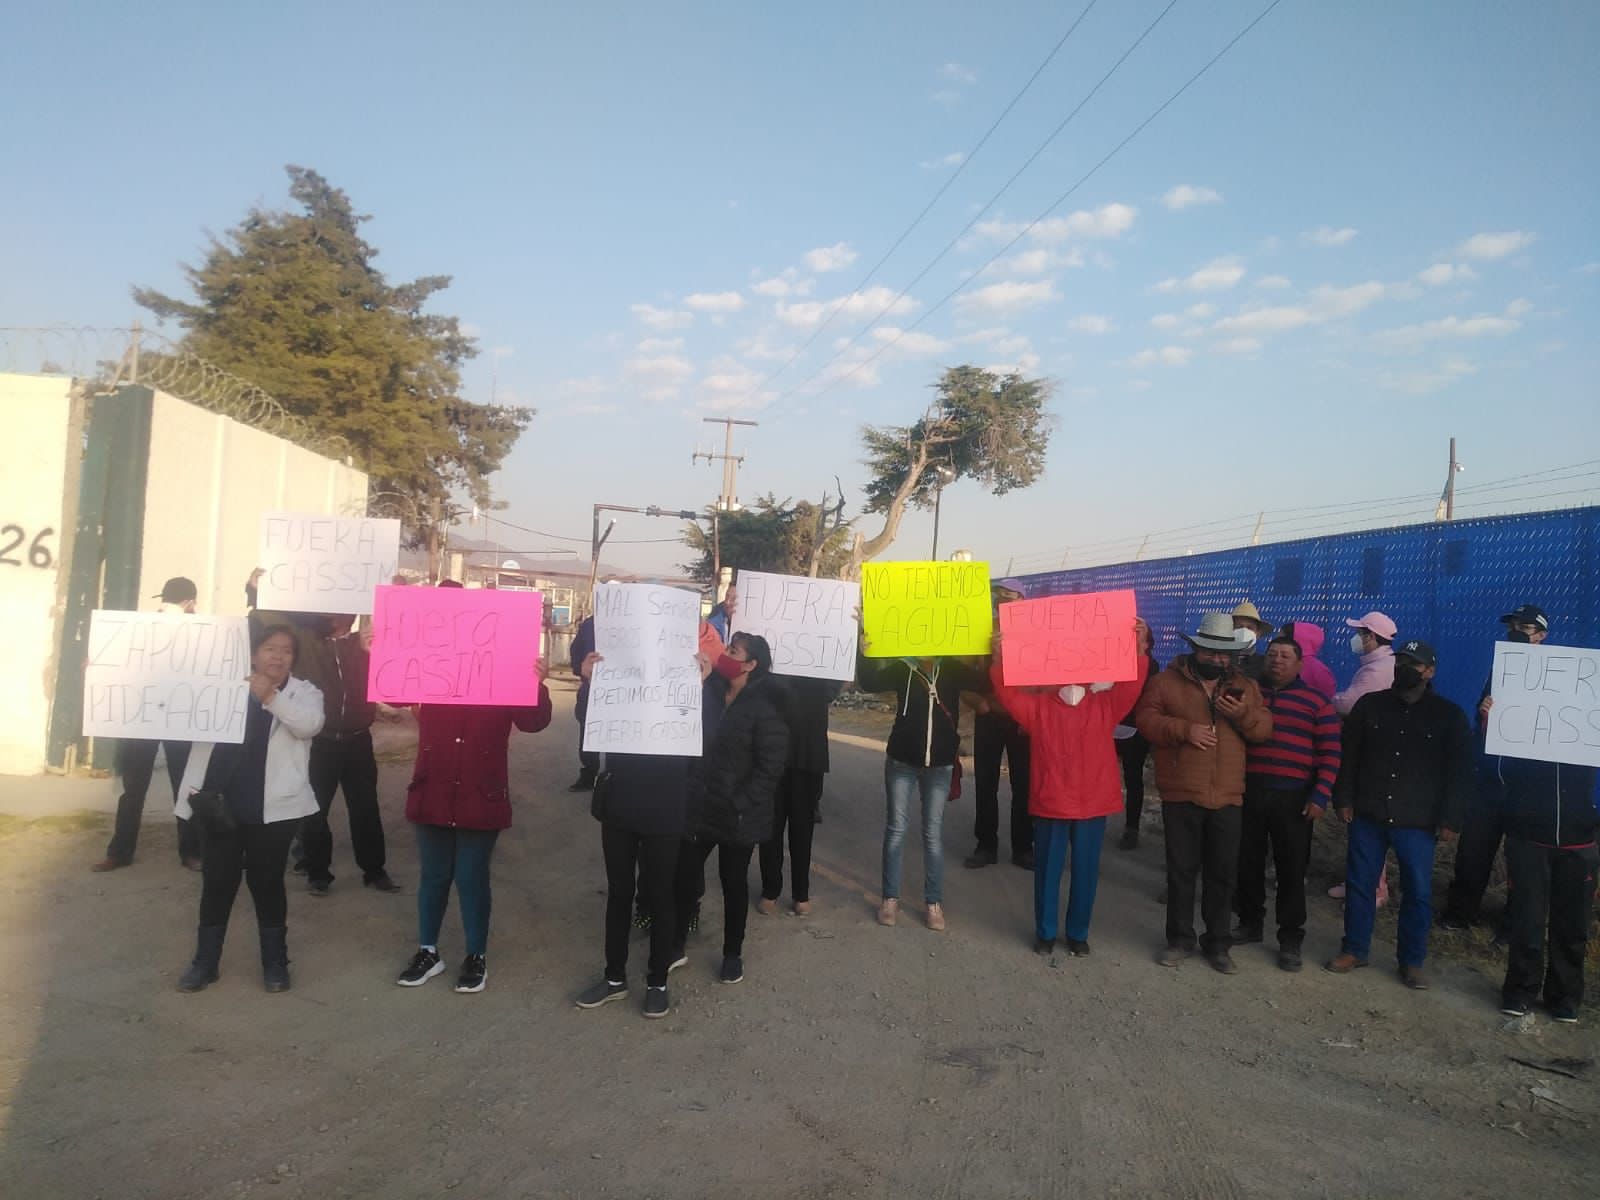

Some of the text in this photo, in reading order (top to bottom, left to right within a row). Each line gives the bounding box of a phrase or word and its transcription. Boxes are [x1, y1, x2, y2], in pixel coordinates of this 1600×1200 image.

[0, 524, 54, 569] 26
[270, 562, 397, 593] CASSIM
[864, 565, 985, 600] NO TENEMOS
[595, 589, 633, 617] MAL
[743, 577, 846, 625] FUERA
[881, 604, 970, 647] AGUA
[88, 619, 249, 681] ZAPOTLAN
[748, 627, 854, 673] ASSIM
[1018, 632, 1137, 673] CASSIM
[375, 650, 495, 699] CASIM
[591, 685, 663, 706] PEDIMOS
[165, 683, 248, 733] AGUA
